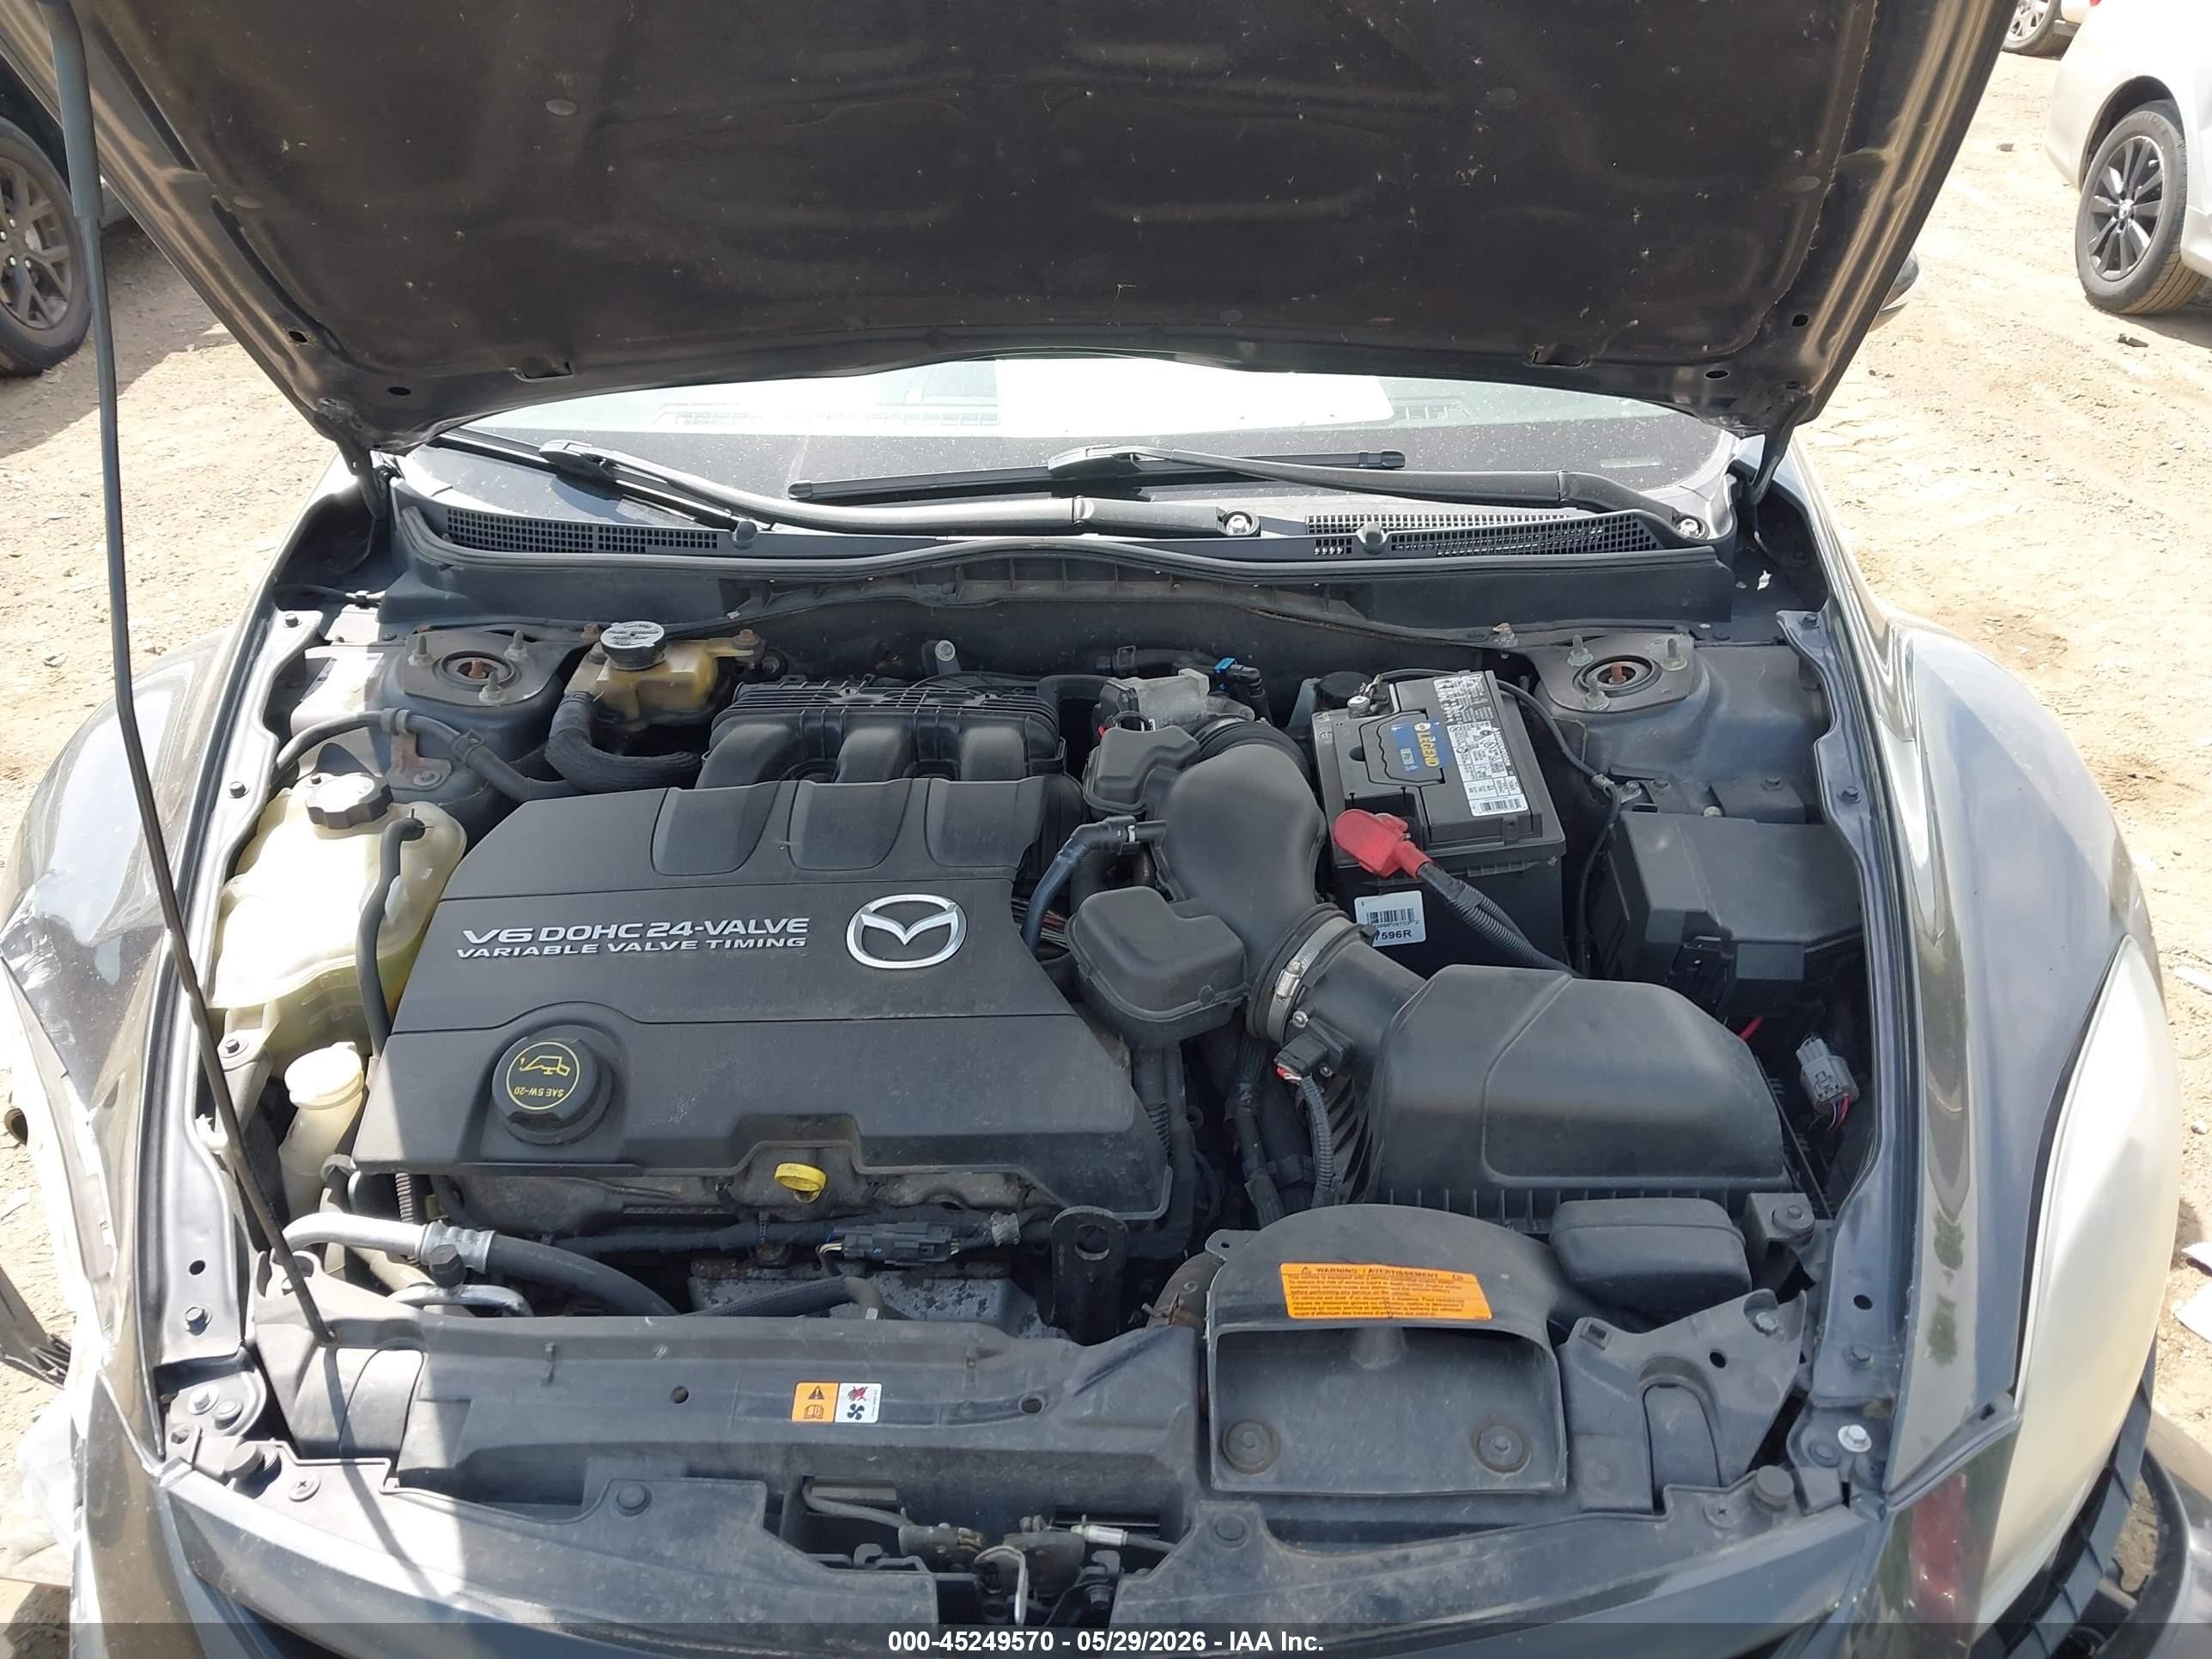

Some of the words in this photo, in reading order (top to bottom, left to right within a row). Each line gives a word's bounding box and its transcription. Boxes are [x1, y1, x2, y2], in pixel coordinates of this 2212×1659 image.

[1416, 732, 1440, 767] LEGEND
[462, 927, 534, 945] V6
[538, 922, 644, 942] DOHC
[646, 917, 811, 938] 24-VALVE
[456, 943, 599, 958] VARIABLE
[607, 939, 699, 953] VALVE
[705, 937, 807, 950] TIMING
[513, 1085, 544, 1097] 5W-20
[544, 1088, 565, 1097] SAE
